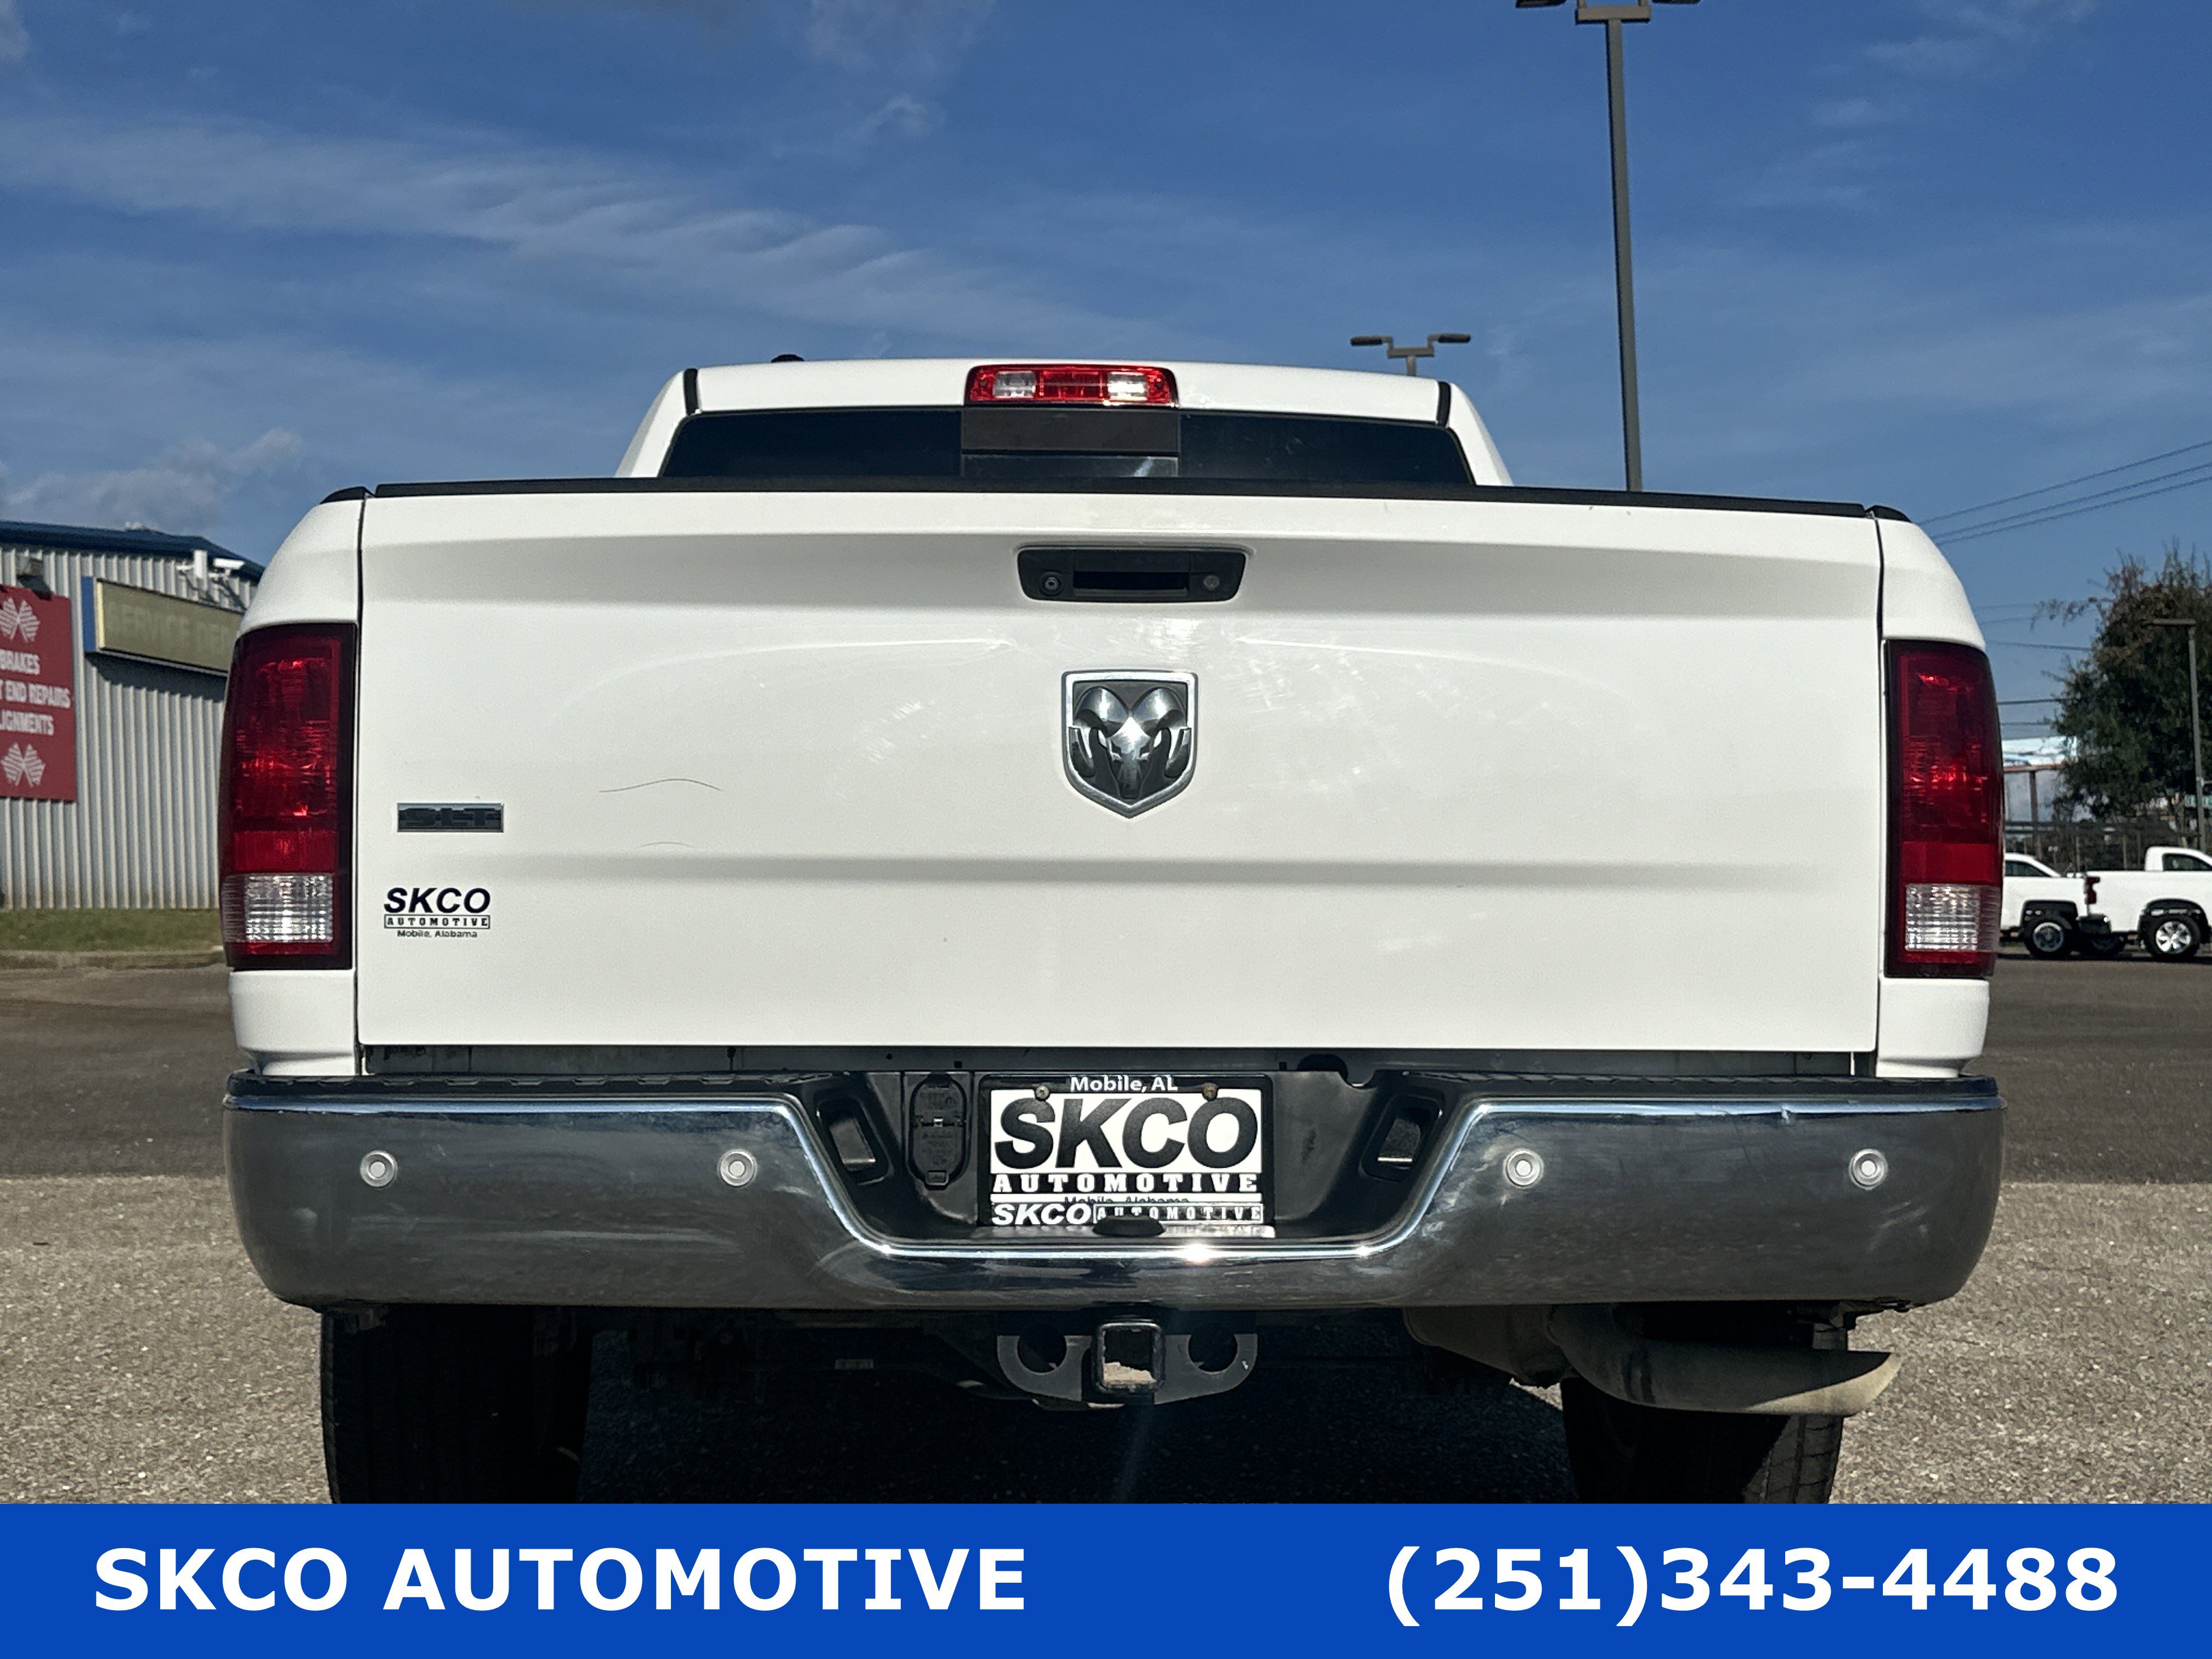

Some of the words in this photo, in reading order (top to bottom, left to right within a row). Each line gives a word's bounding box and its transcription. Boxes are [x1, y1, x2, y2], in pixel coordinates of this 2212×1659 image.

[5, 679, 27, 702] END
[29, 683, 71, 708] REPAIRS
[384, 887, 491, 913] SKCO
[387, 917, 488, 926] AUTOMOTIVE
[435, 929, 478, 938] Alabama
[1070, 1075, 1147, 1093] Mobile,
[1152, 1075, 1178, 1091] AL
[994, 1097, 1258, 1169] SKCO
[993, 1173, 1257, 1193] AUTOMOTIVE
[991, 1203, 1092, 1226] SKCO
[1097, 1206, 1261, 1221] AUTOMOTIVE
